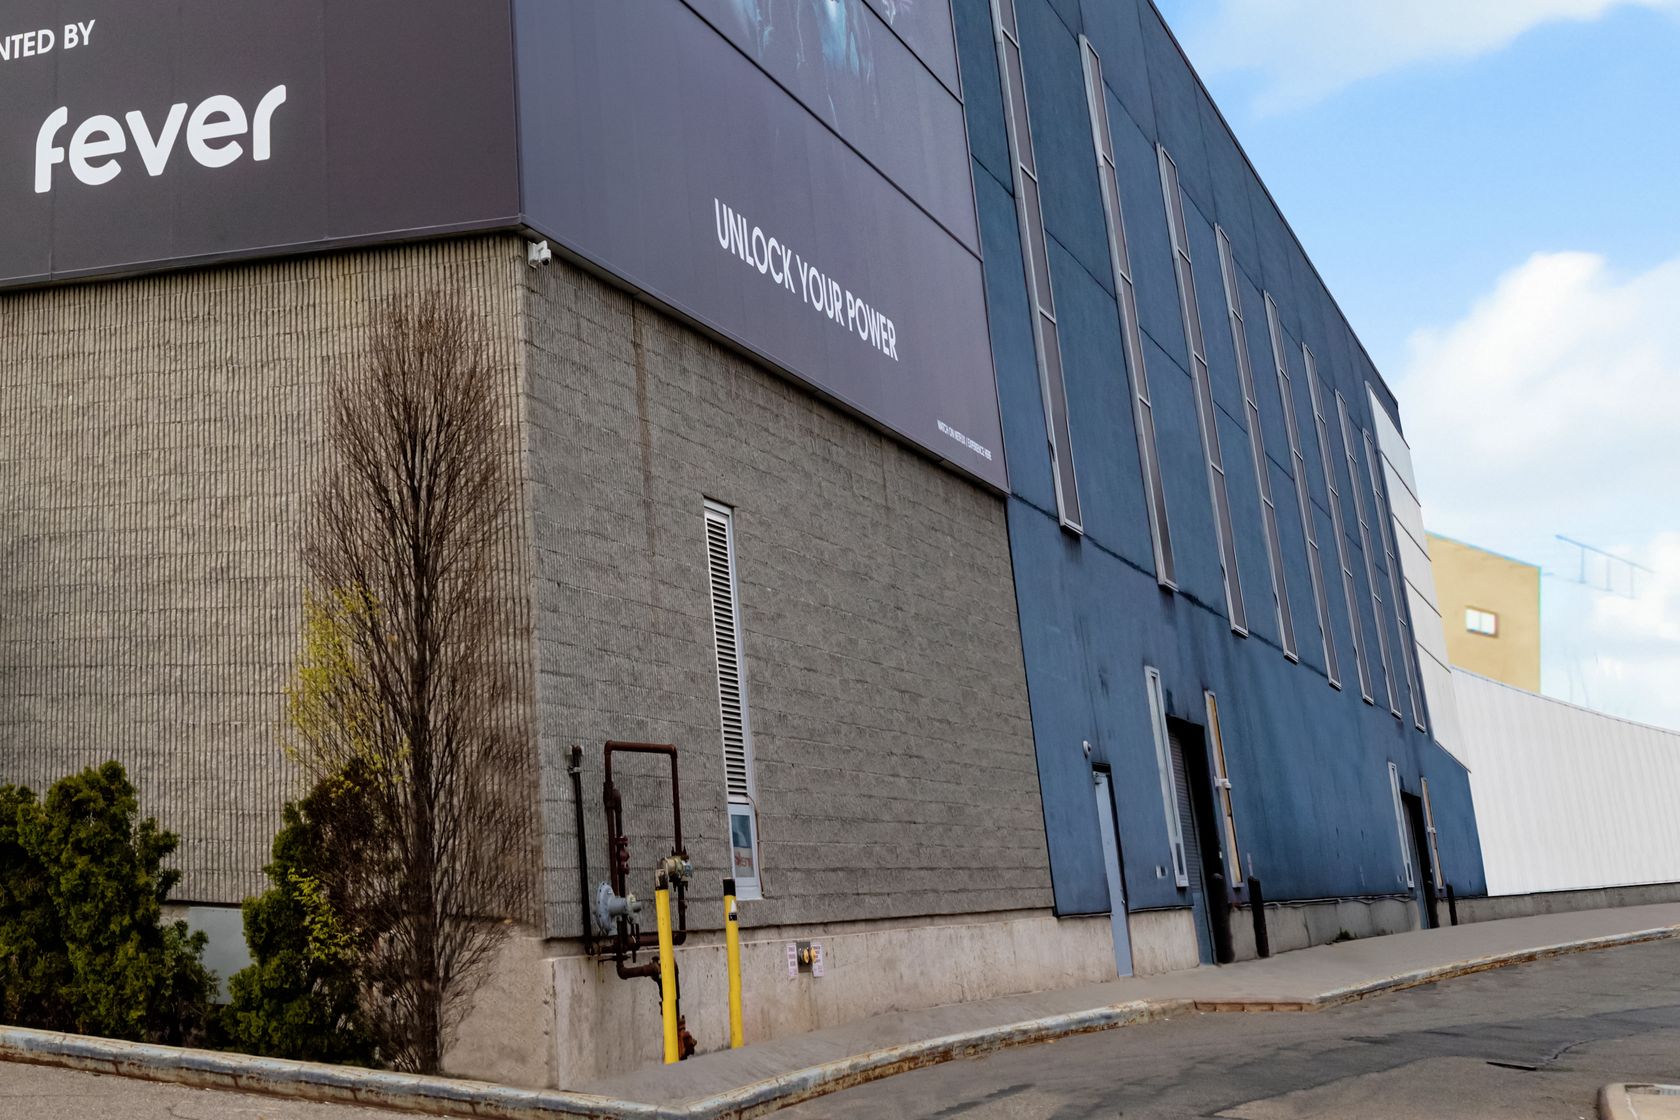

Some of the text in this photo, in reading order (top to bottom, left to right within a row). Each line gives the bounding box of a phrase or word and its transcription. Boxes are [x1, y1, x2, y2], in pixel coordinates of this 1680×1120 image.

[63, 19, 96, 50] BY
[34, 84, 287, 194] fever
[714, 197, 899, 362] UNLOCK YOUR POWER
